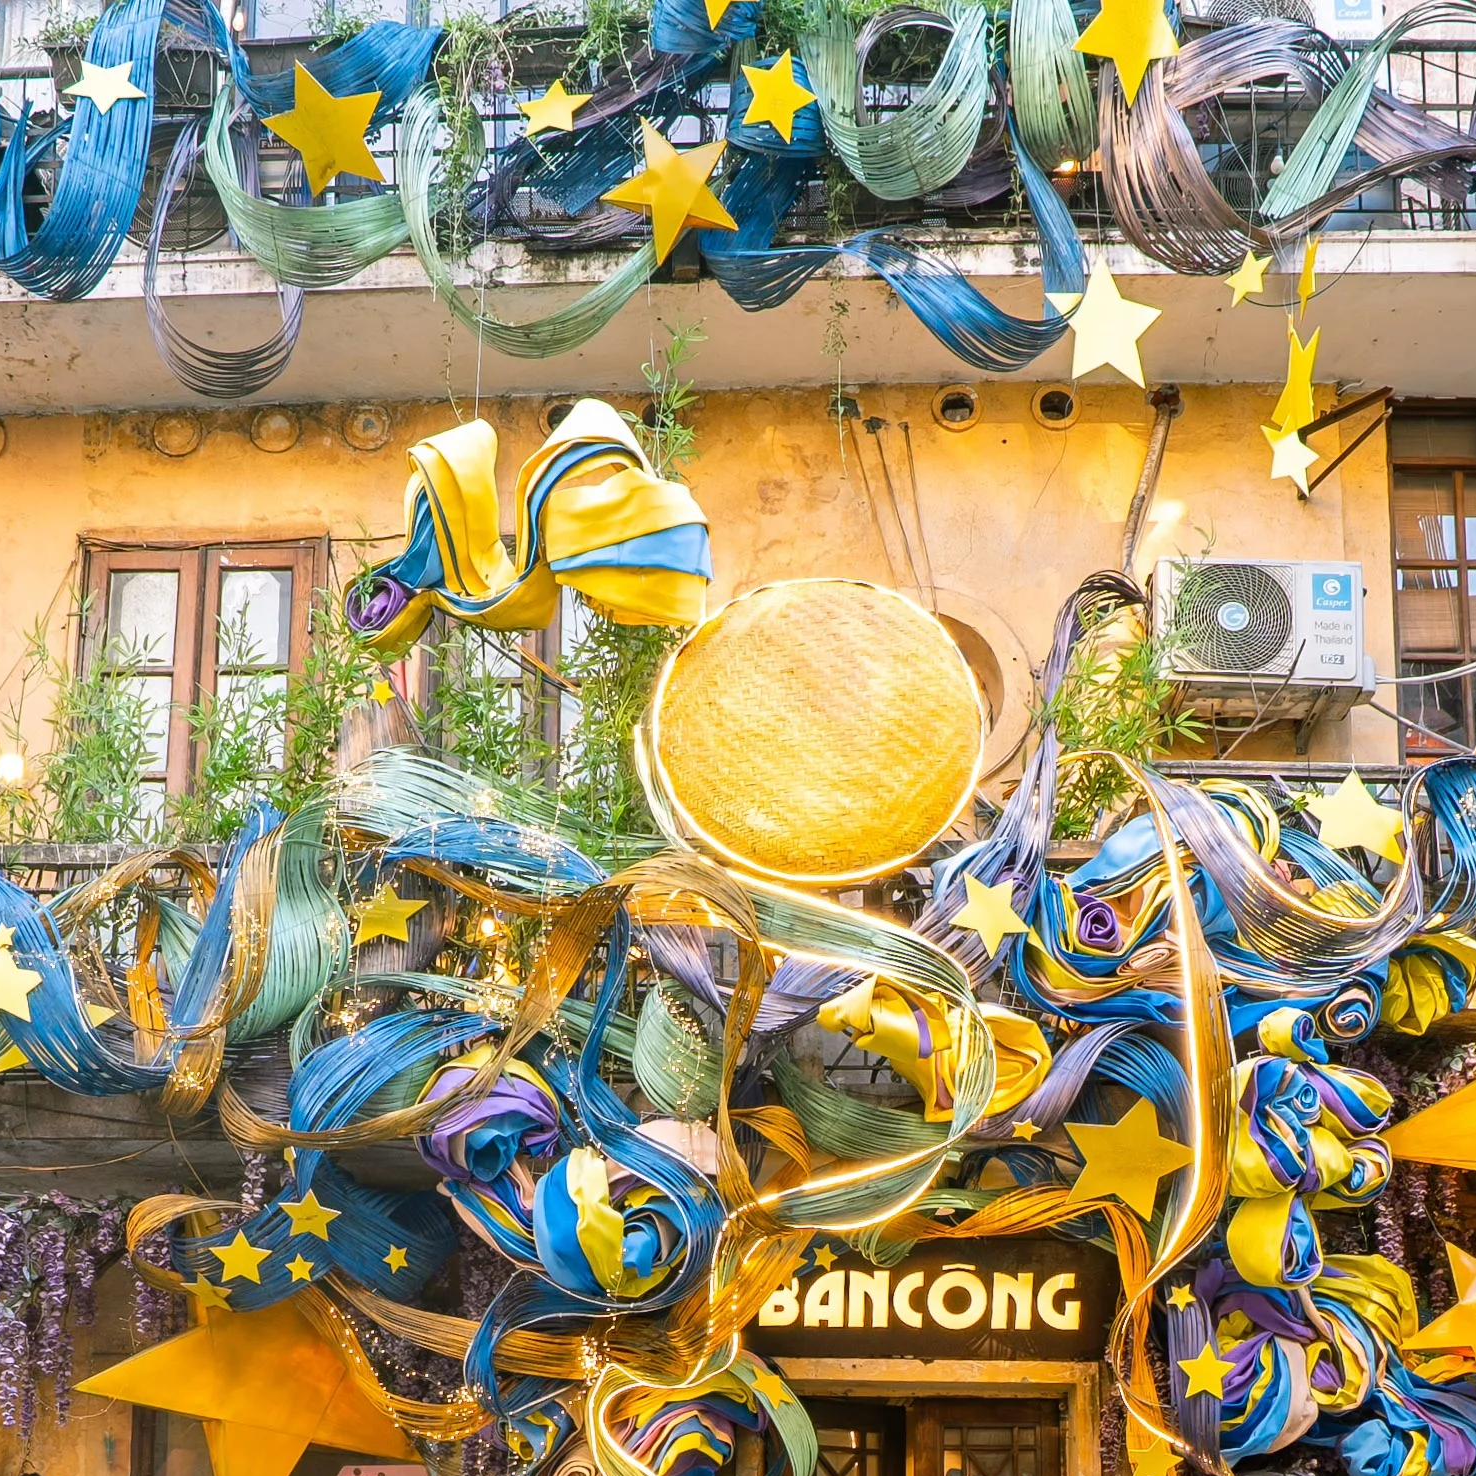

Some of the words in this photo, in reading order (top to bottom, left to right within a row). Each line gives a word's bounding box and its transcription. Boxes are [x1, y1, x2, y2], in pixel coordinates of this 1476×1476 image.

[1316, 596, 1349, 609] Casper
[1314, 621, 1341, 632] Made
[1344, 621, 1353, 632] in
[1314, 635, 1353, 646] Thailand
[1322, 655, 1342, 664] R32
